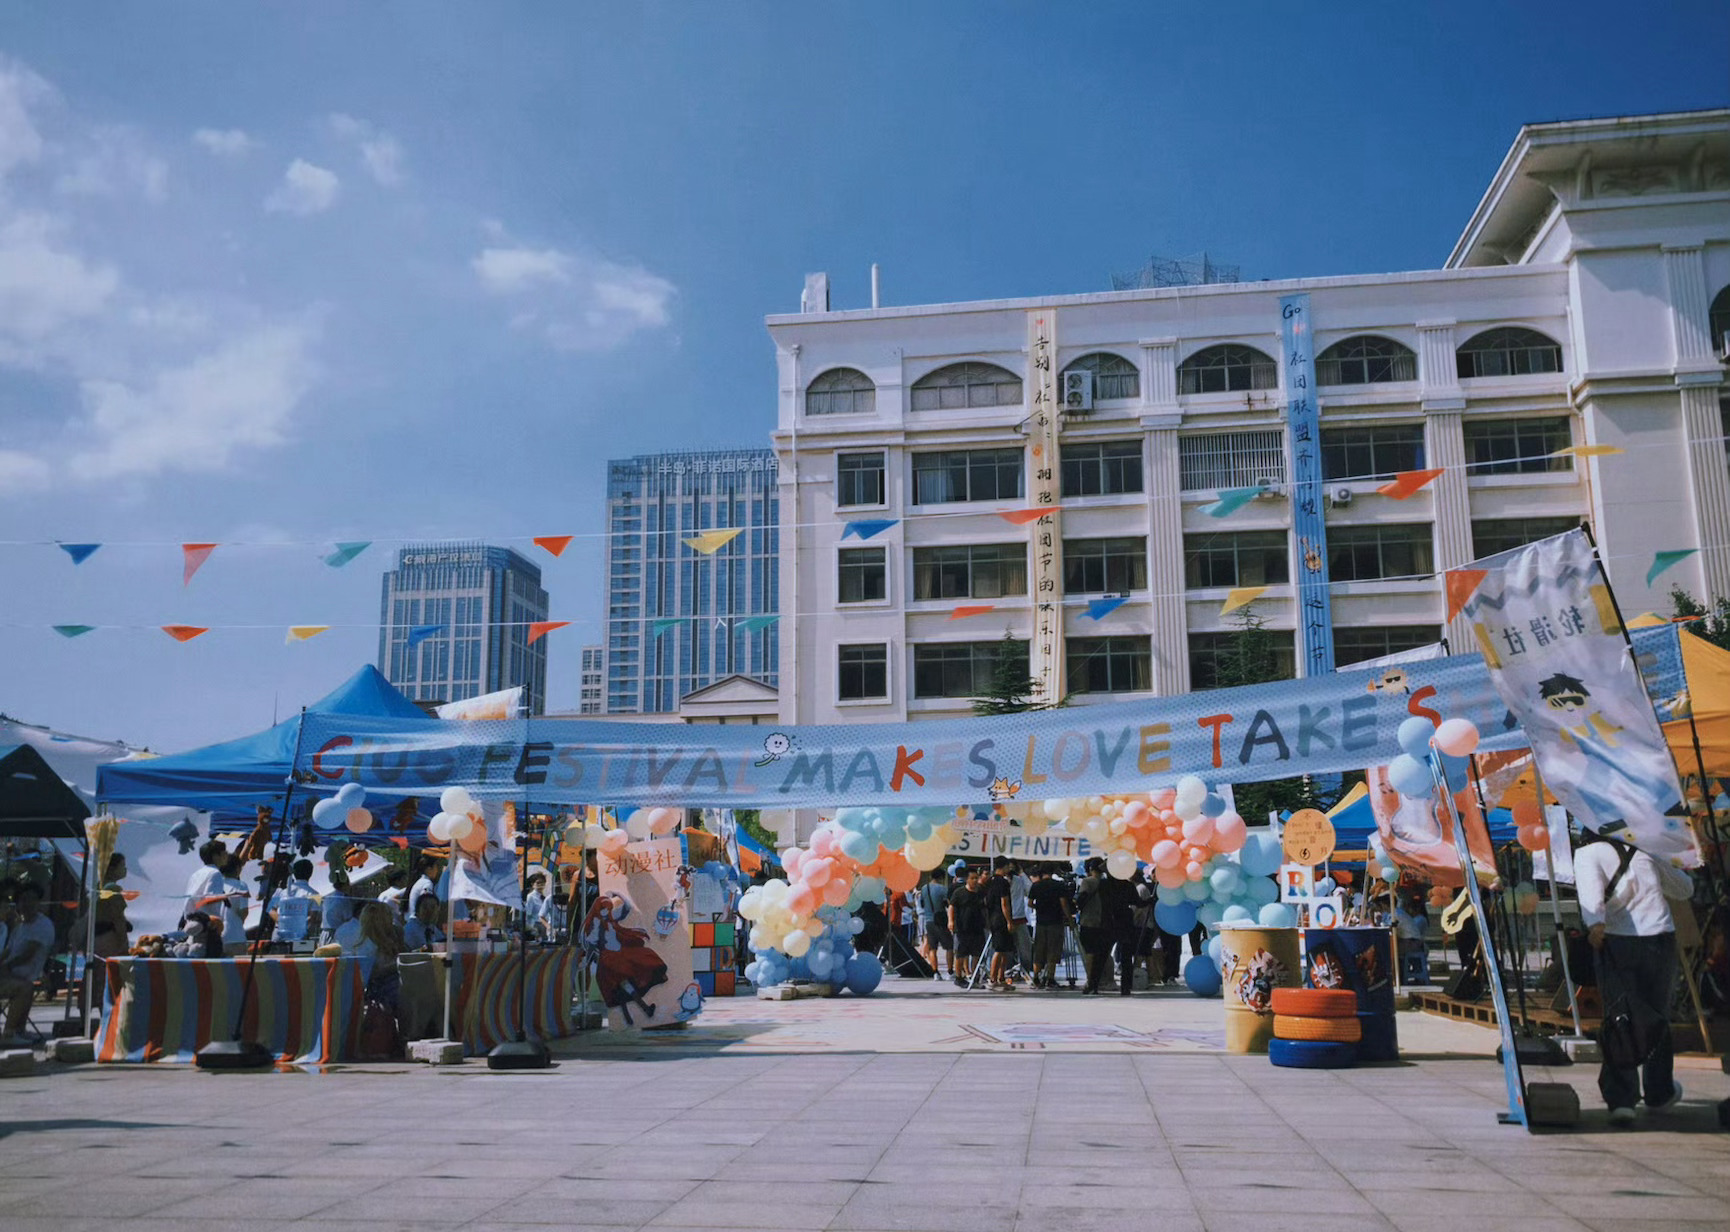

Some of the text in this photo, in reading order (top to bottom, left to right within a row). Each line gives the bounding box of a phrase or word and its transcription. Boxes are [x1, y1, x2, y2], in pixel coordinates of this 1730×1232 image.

[1282, 303, 1302, 320] Go
[477, 740, 757, 794] FESTIVAL
[778, 738, 997, 794] MAKES
[1021, 722, 1173, 785] LOVE
[981, 833, 1091, 857] INFINITE
[605, 848, 678, 877] 动漫社
[1287, 871, 1308, 897] R
